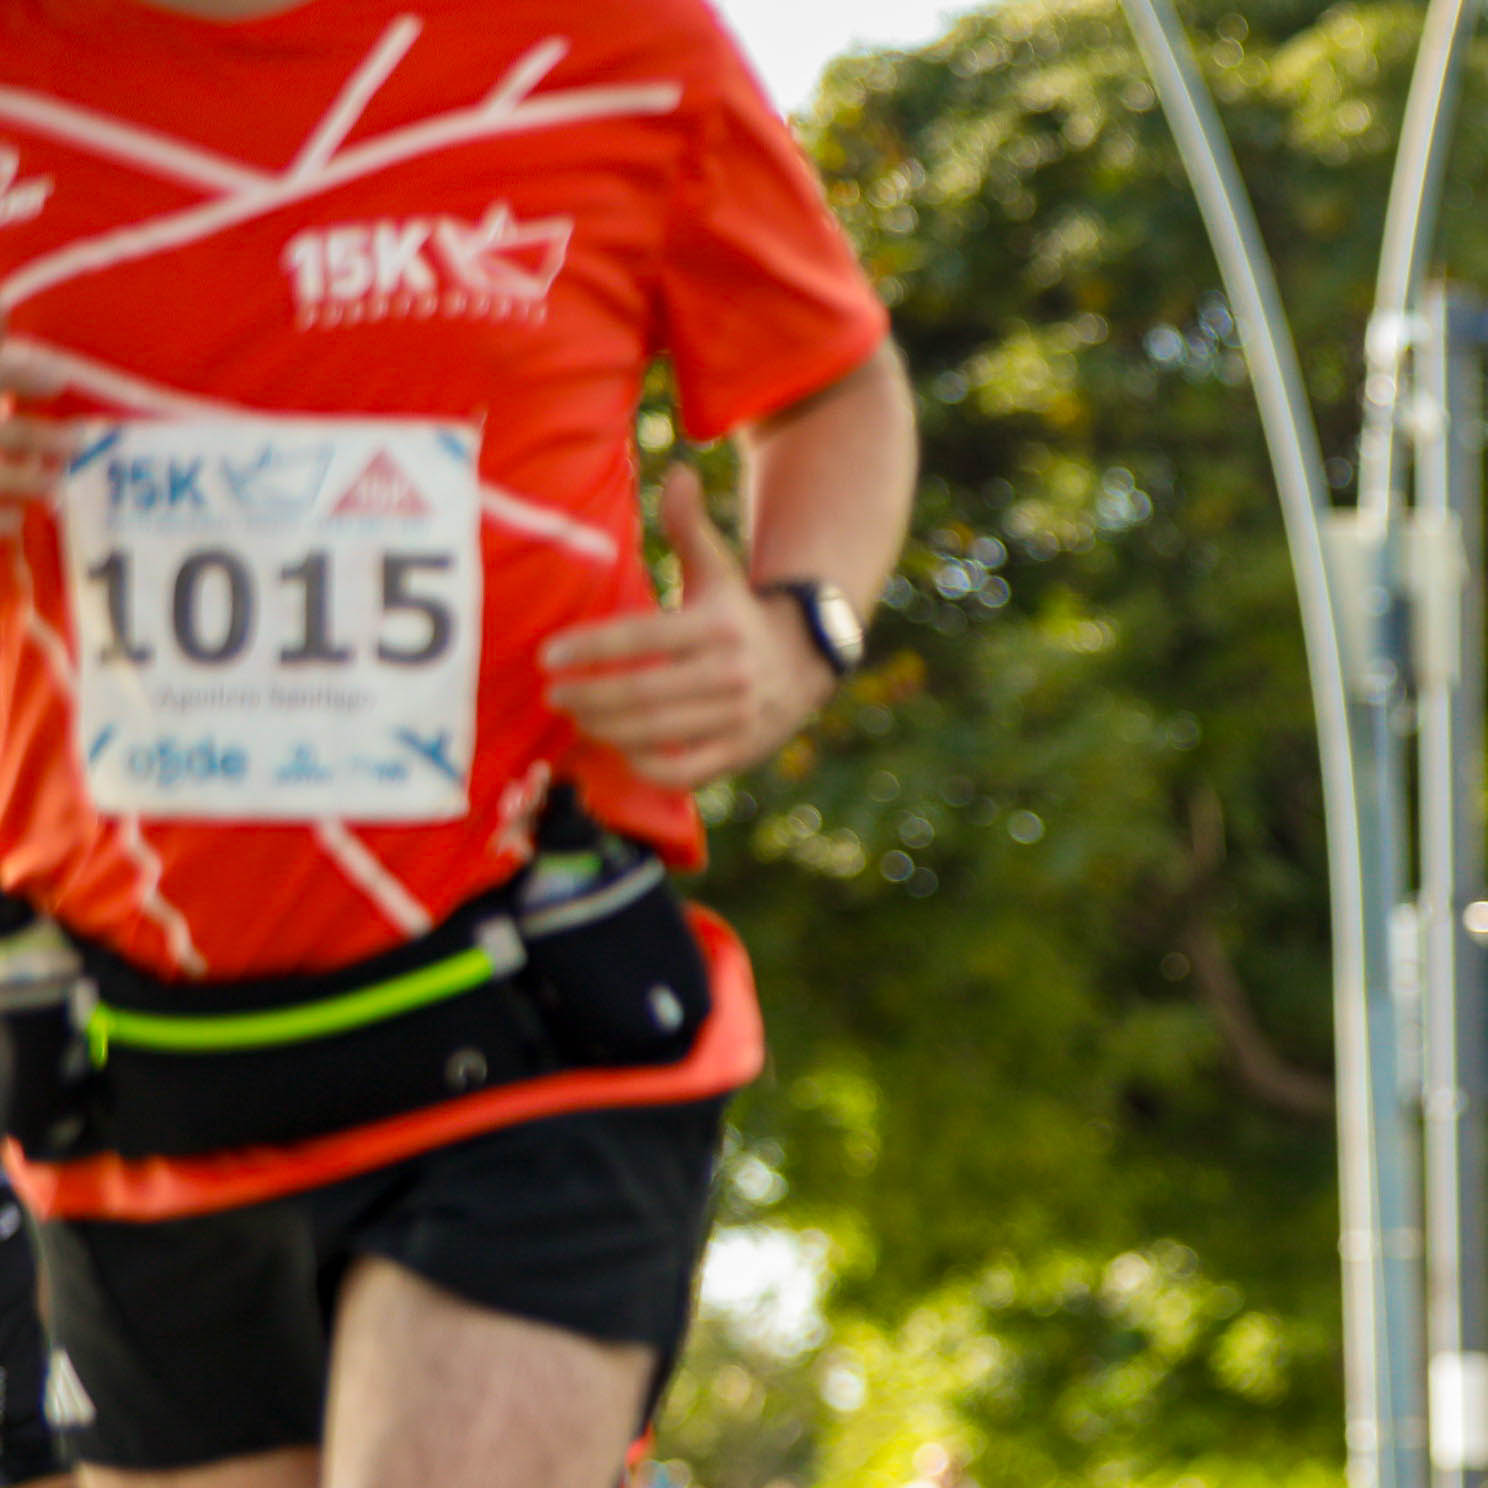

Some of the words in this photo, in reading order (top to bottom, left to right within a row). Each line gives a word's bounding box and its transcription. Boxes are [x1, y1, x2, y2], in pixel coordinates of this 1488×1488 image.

[281, 219, 437, 300] 15K
[107, 453, 207, 510] 15K
[87, 547, 456, 666] 1015
